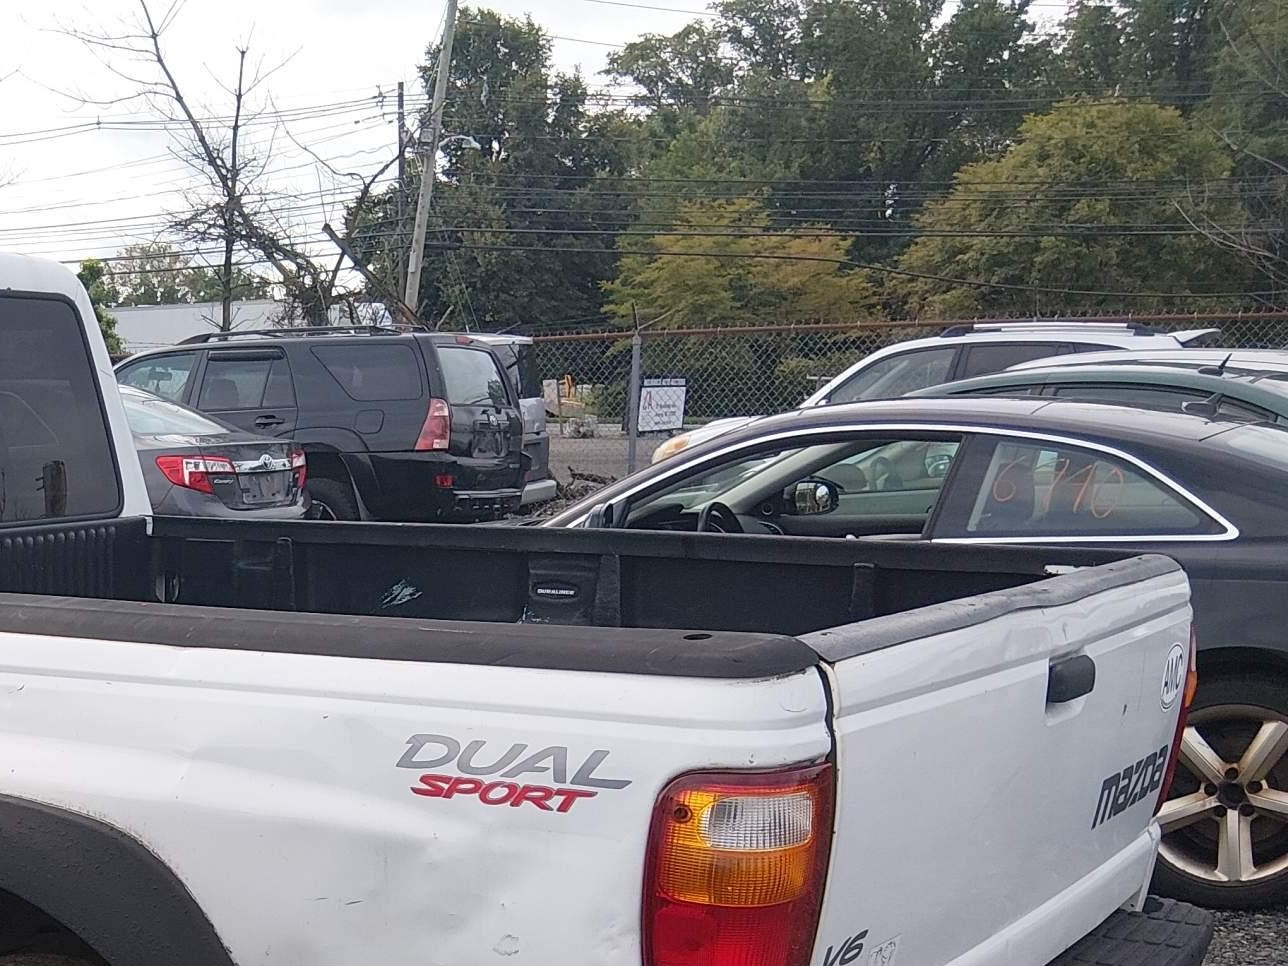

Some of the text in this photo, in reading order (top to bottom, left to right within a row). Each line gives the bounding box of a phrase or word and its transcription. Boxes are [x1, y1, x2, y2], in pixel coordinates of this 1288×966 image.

[1164, 654, 1183, 695] AMC
[395, 733, 633, 790] DUAL
[410, 773, 598, 813] SPORT
